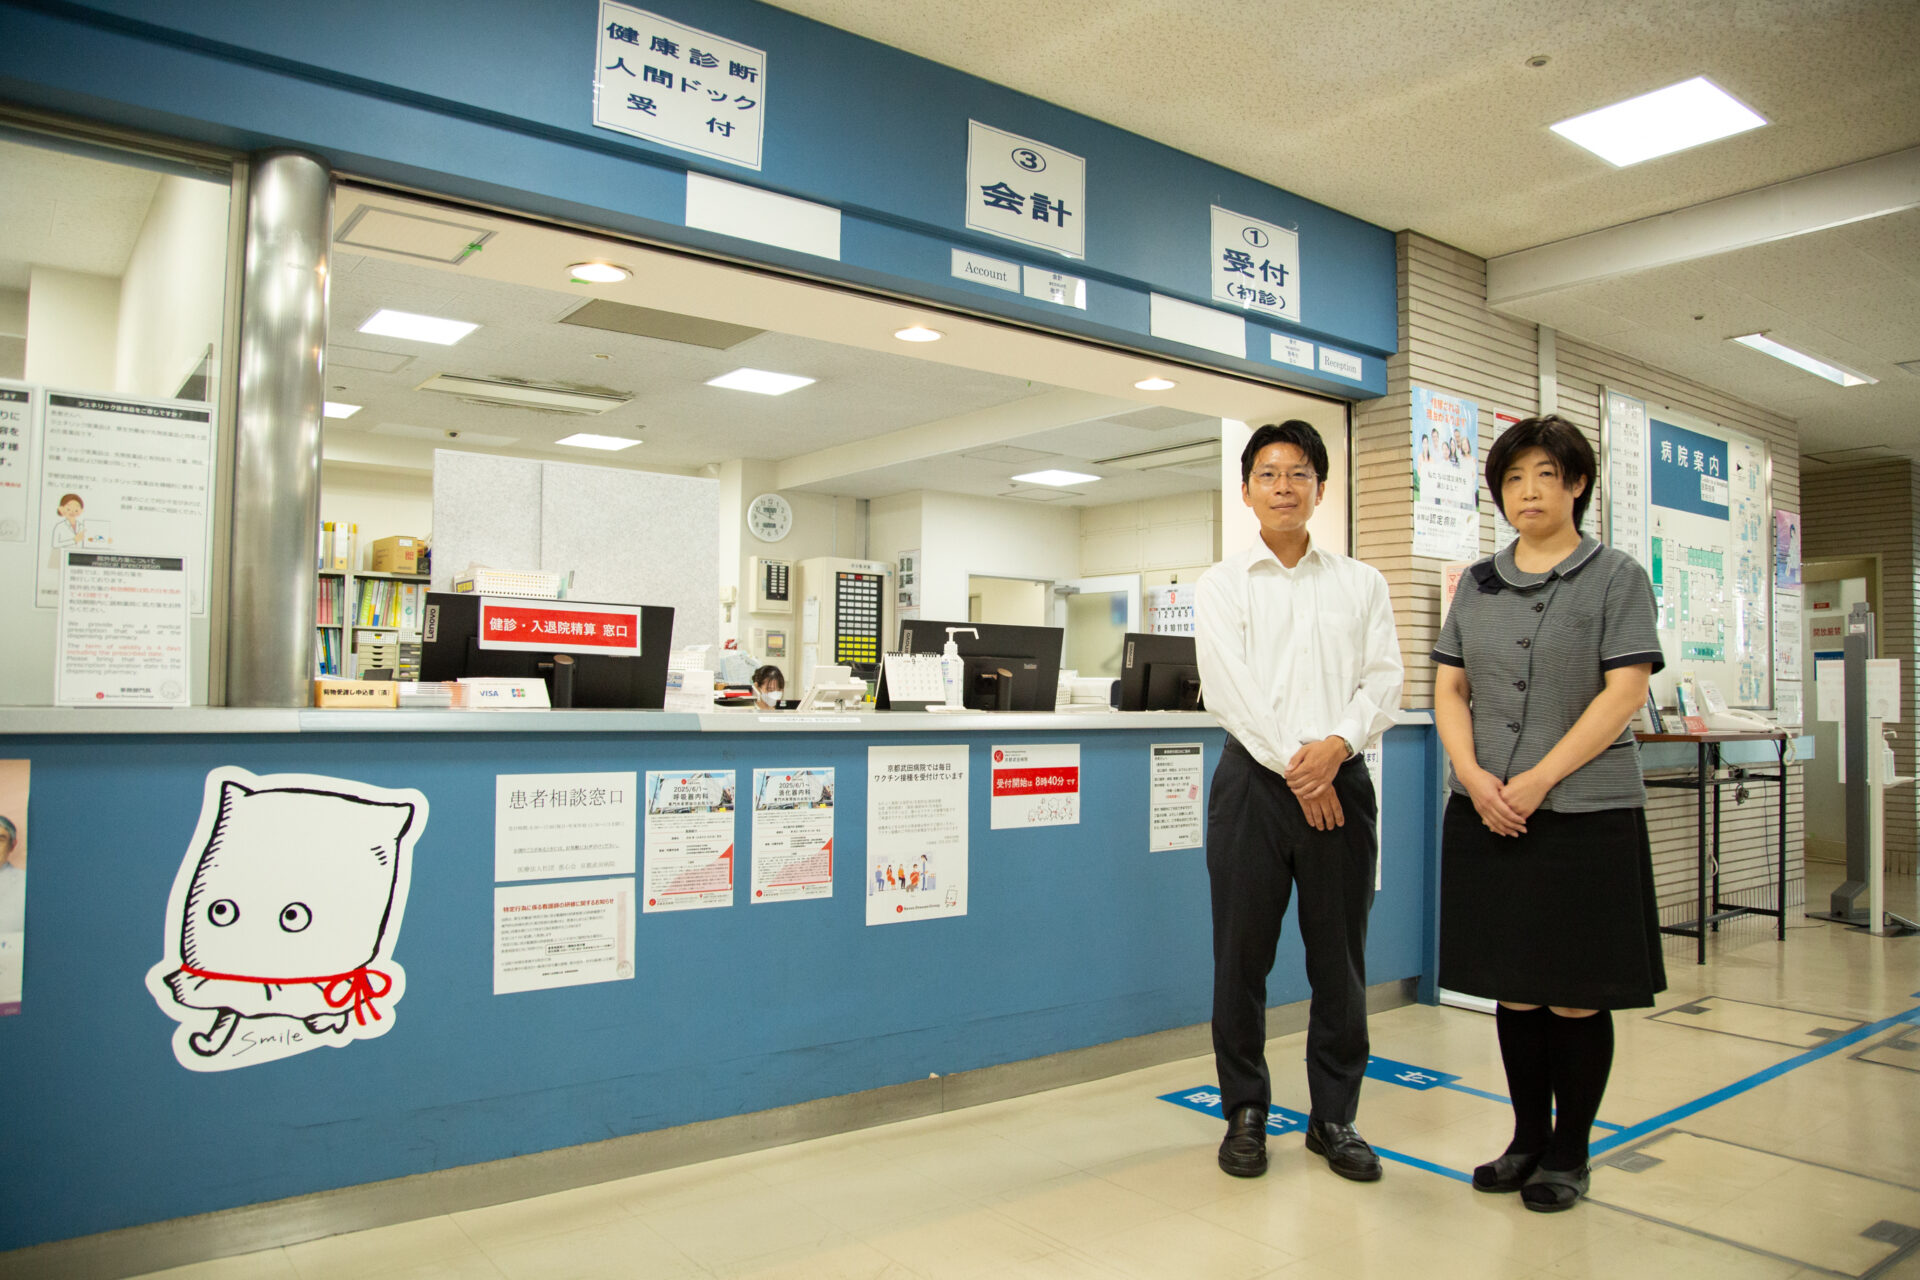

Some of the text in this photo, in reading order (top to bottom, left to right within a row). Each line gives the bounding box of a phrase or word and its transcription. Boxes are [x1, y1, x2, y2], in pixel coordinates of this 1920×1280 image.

[606, 22, 758, 83] 健康診断
[606, 57, 757, 111] 人間ドック
[980, 182, 1072, 228] 会計
[965, 262, 1008, 282] Account
[1223, 248, 1289, 287] 受付
[1324, 355, 1357, 374] Reception
[1660, 440, 1720, 477] 病院案内
[426, 608, 437, 639] Lenovo
[489, 617, 628, 637] 健診・入退院精算 窓口
[874, 772, 964, 782] ワクチン接種を受付けています
[887, 763, 951, 772] 京都武田病院では毎日
[996, 777, 1033, 789] 受付開始は
[1035, 776, 1064, 787] 8時40分
[508, 788, 624, 809] 患者相談窓口
